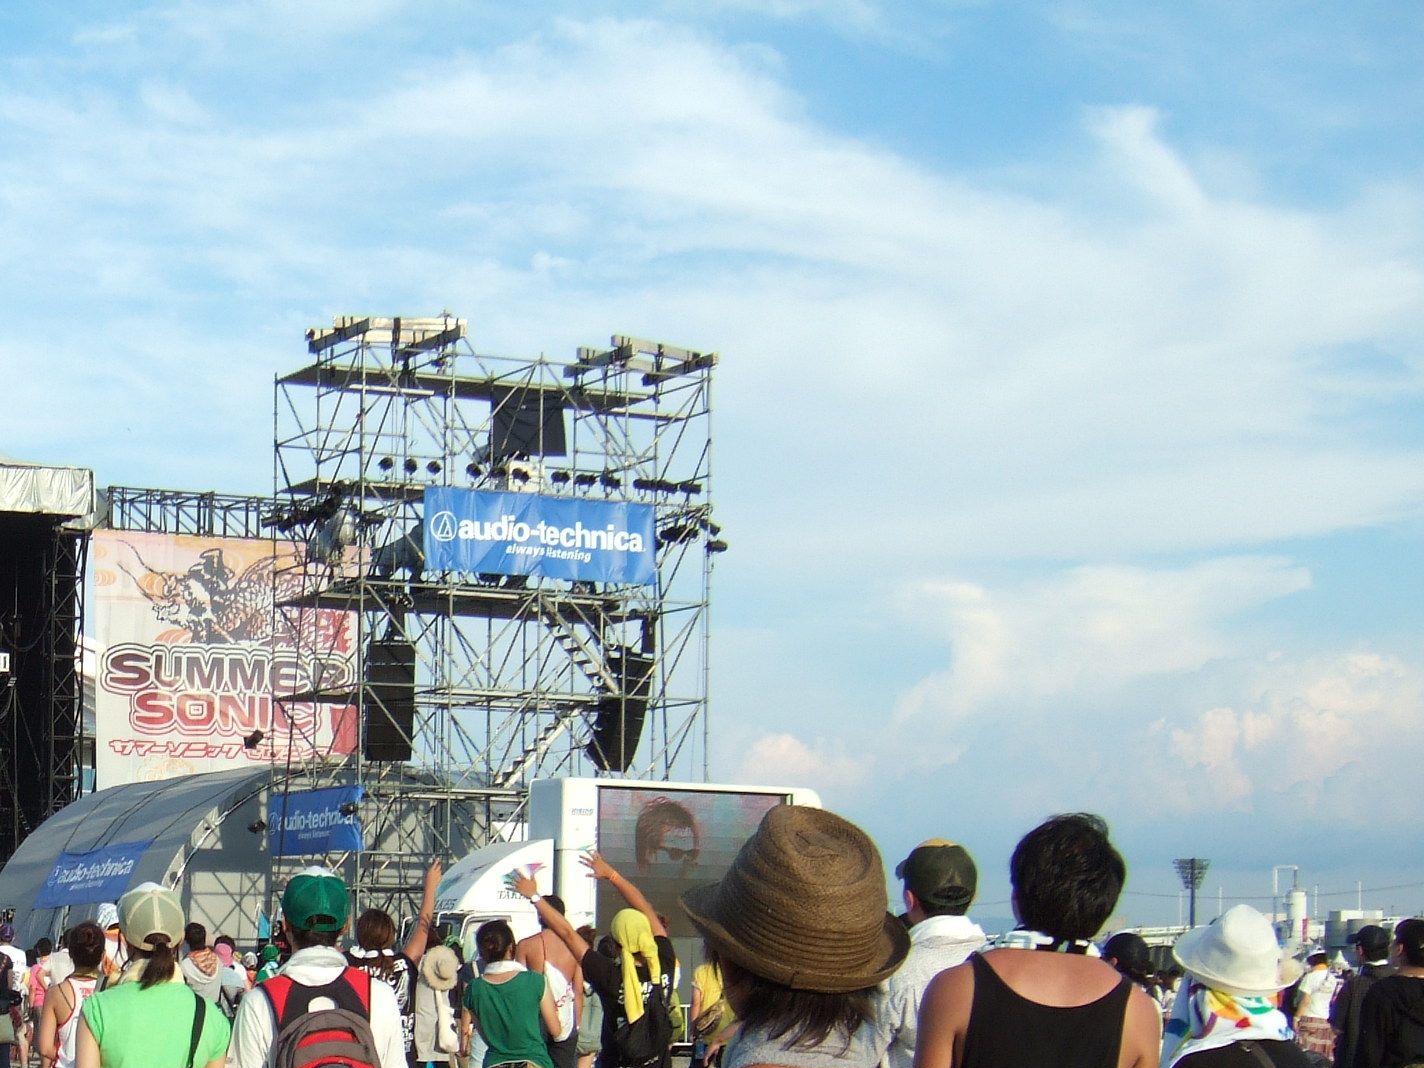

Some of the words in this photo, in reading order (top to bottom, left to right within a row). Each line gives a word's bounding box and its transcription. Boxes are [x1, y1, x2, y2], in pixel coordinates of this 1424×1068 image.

[458, 515, 644, 553] audio-technica
[505, 543, 546, 558] always
[545, 546, 592, 563] listening
[104, 647, 350, 695] SUMMER
